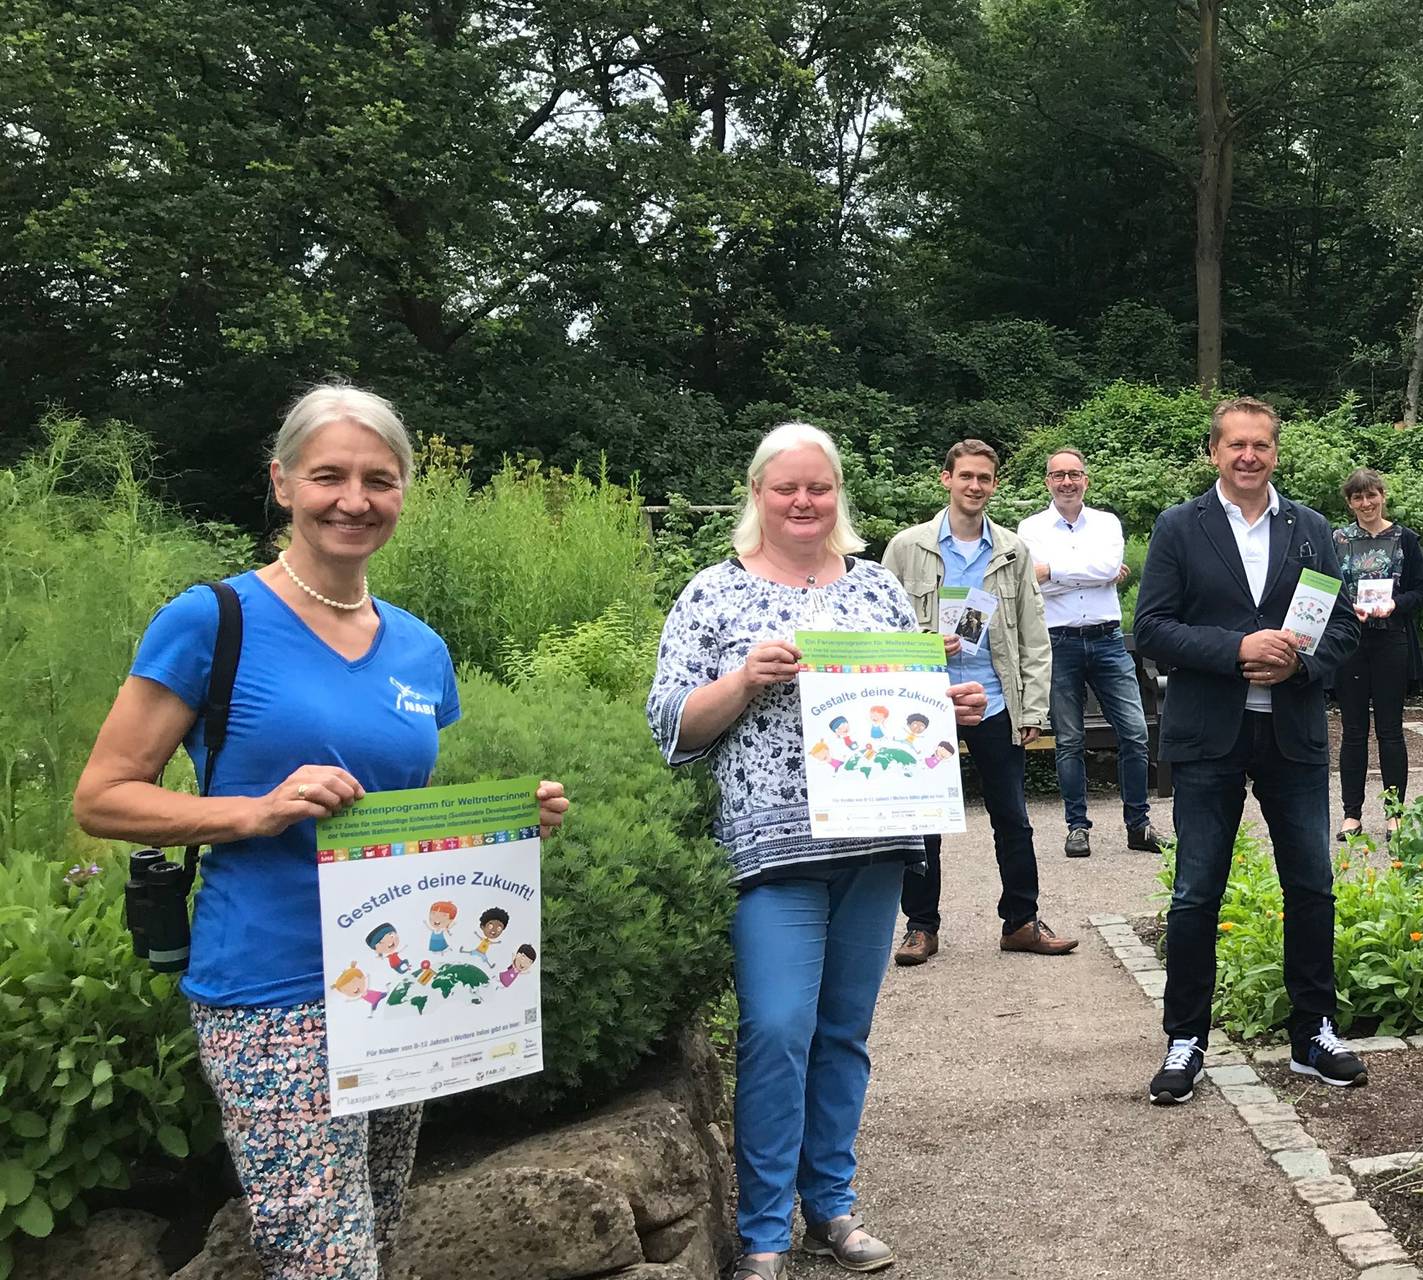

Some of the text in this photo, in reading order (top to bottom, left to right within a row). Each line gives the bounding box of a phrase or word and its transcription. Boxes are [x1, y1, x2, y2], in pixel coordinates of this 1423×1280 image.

[811, 687, 948, 717] Gestalte deine Zukunft!
[351, 801, 439, 817] Ferienprogramm
[441, 799, 454, 809] für
[458, 791, 530, 806] Weltretter:innen
[337, 871, 535, 929] Gestalte deine Zukunft!
[366, 1049, 378, 1058] Für
